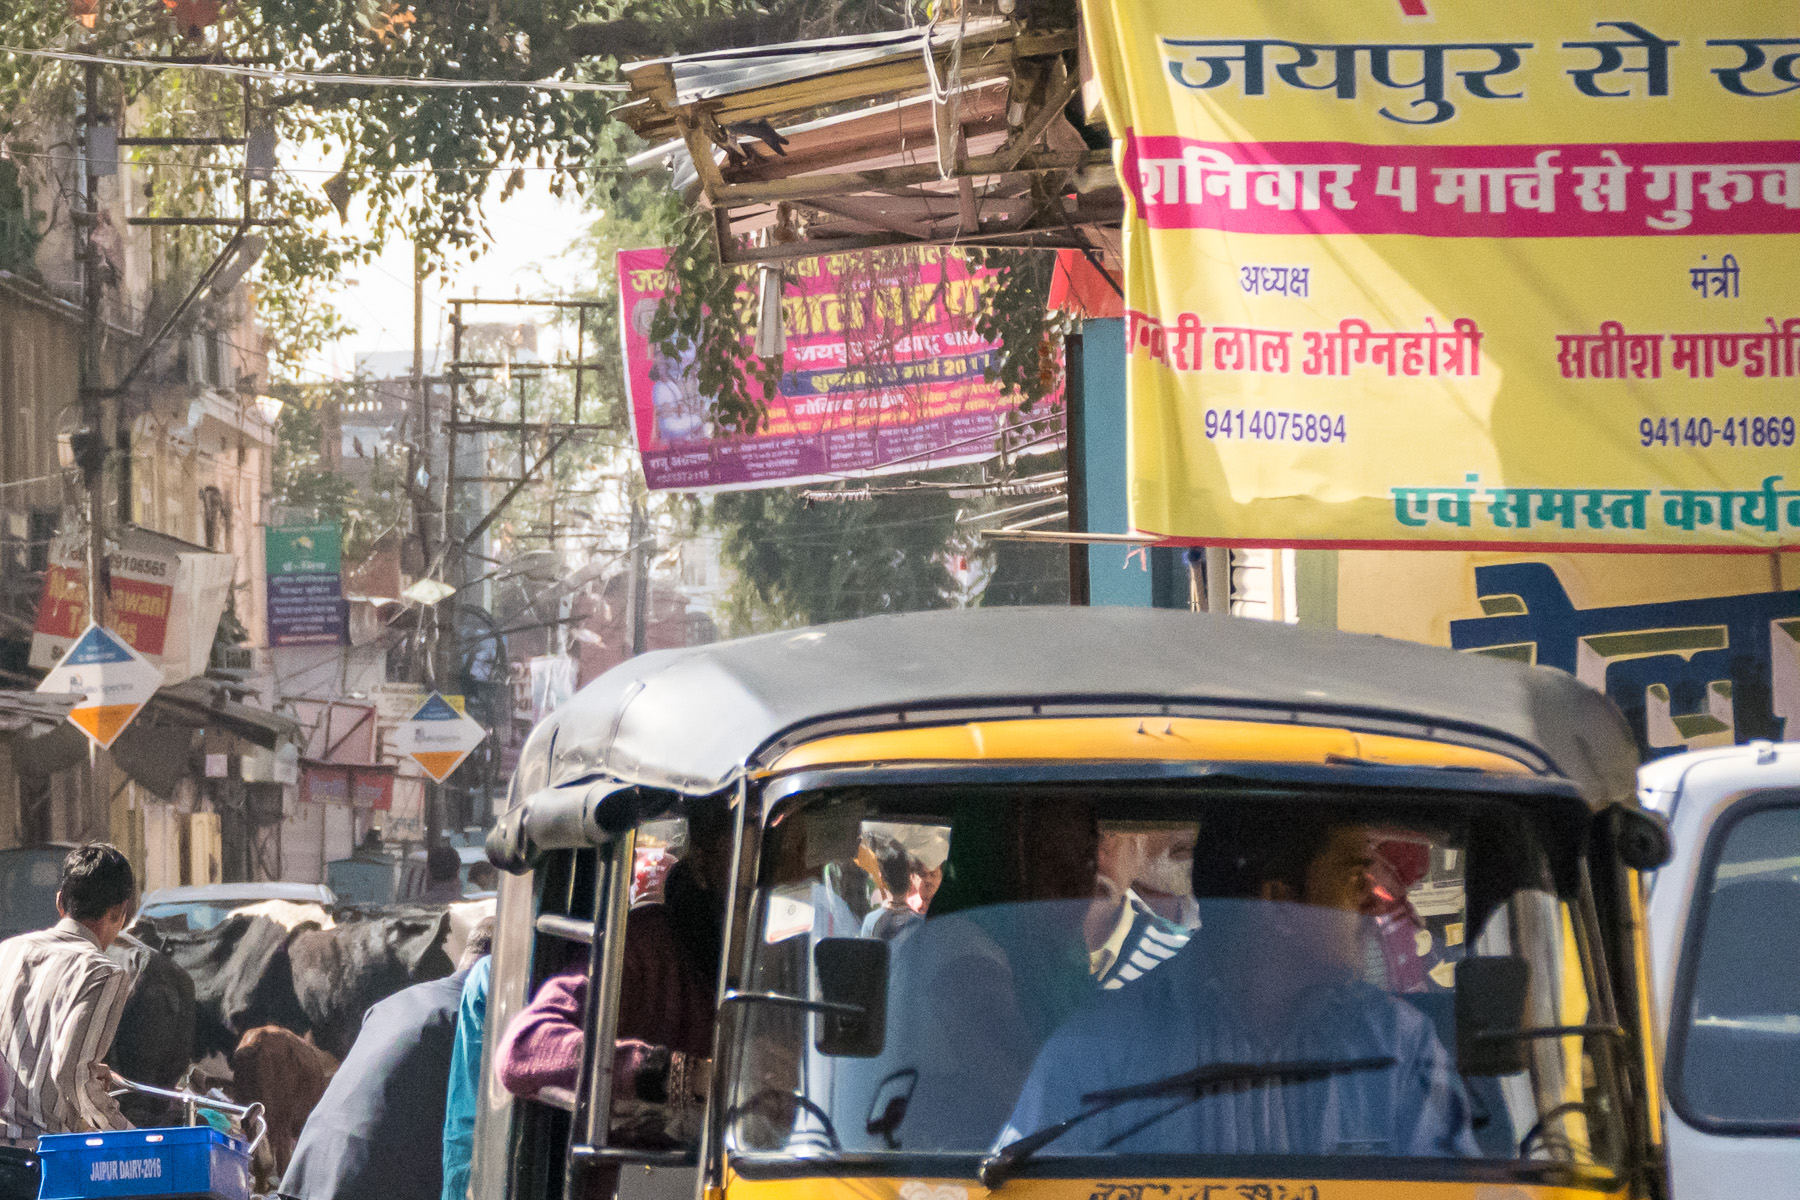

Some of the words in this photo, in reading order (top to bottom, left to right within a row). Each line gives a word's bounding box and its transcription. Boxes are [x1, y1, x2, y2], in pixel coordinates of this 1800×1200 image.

[1162, 37, 1535, 124] जयपुर
[1562, 21, 1680, 97] से
[1138, 146, 1361, 211] शनिवार
[1430, 151, 1561, 214] मार्च
[1571, 150, 1634, 212] से
[1641, 163, 1800, 230] गुरुव
[1240, 266, 1310, 297] अध्यक्ष
[1689, 254, 1741, 298] मंत्री
[1213, 326, 1293, 373] लाल
[1303, 317, 1483, 376] अग्निहोत्री
[1555, 320, 1665, 379] सतीश
[1204, 409, 1347, 444] 9414075894
[1639, 415, 1796, 448] 94140-41869
[1390, 474, 1485, 528] एवं
[1485, 488, 1652, 530] समस्त
[90, 1161, 118, 1182] JAIPUR
